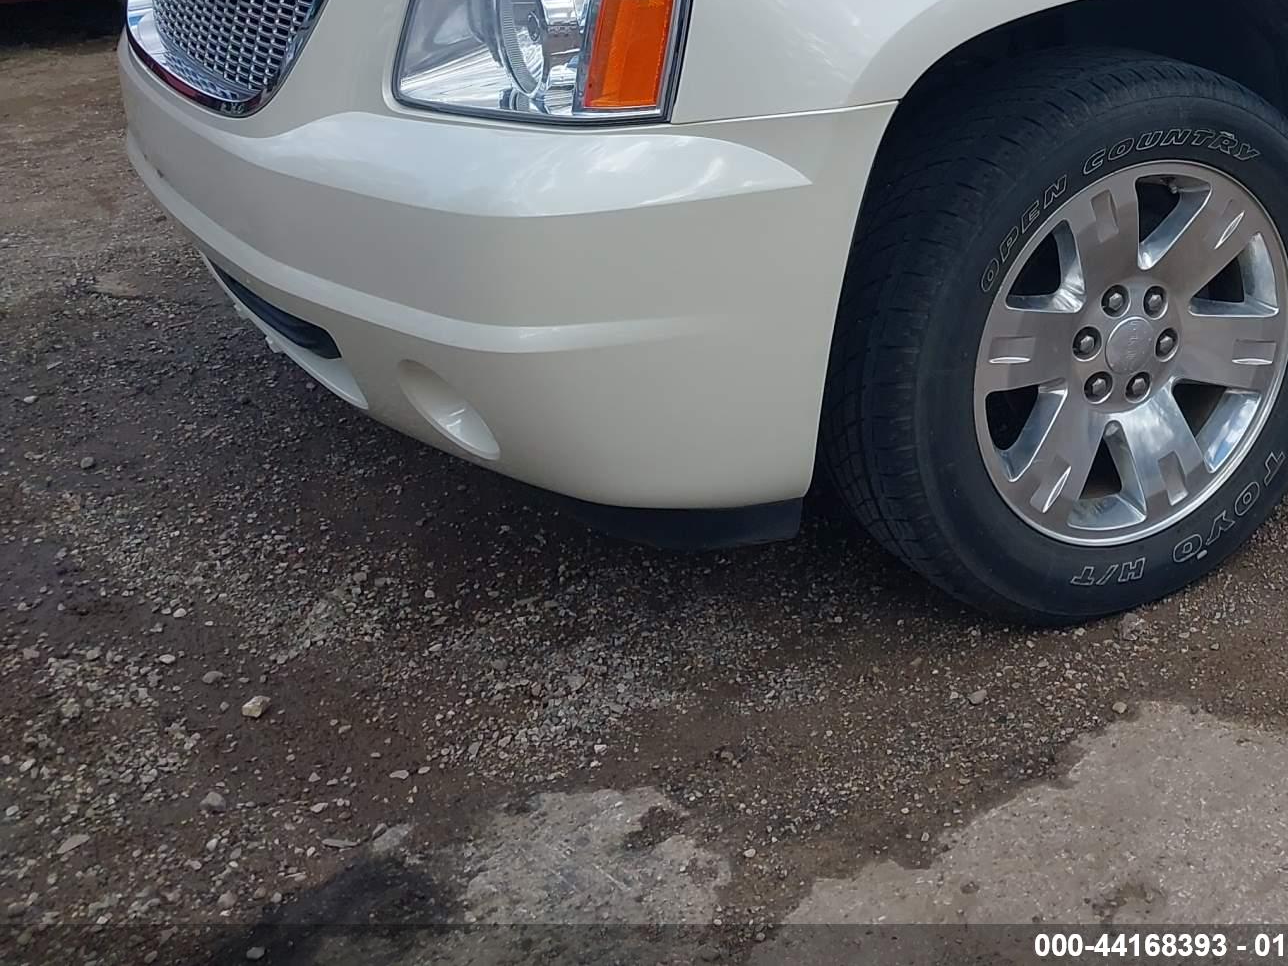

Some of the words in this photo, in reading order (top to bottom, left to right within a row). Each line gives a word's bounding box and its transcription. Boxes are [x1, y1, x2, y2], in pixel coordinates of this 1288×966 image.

[981, 175, 1067, 292] OPEN
[1083, 128, 1260, 175] COUNTRY
[1173, 451, 1286, 563] TOYO
[1071, 557, 1146, 586] H/T
